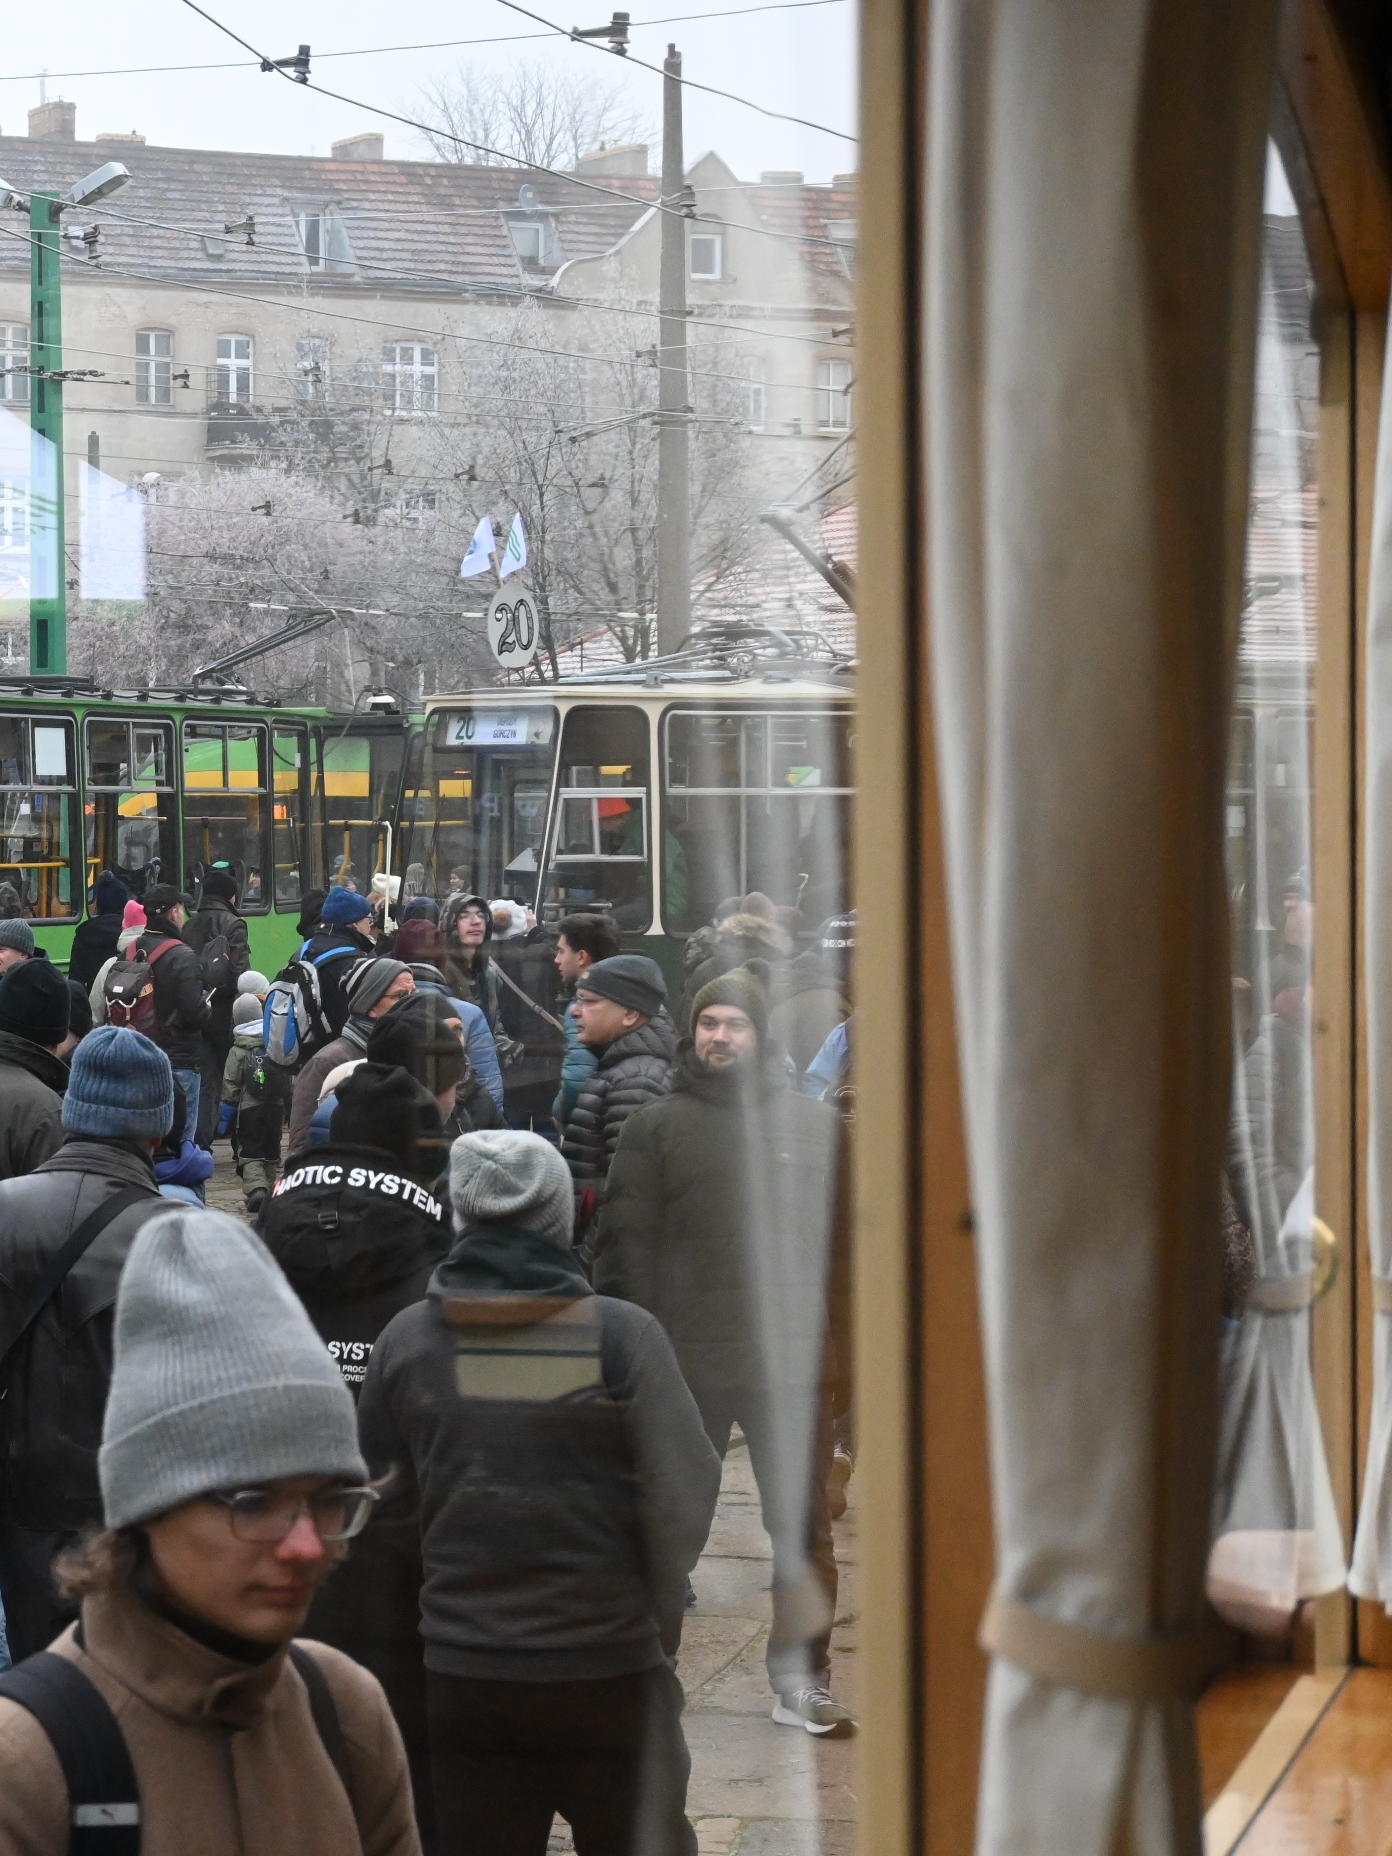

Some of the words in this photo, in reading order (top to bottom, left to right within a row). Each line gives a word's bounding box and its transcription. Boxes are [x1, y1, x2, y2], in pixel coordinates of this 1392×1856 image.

[494, 598, 534, 656] 20
[455, 715, 476, 740] 20
[347, 1167, 443, 1222] SYSTEM
